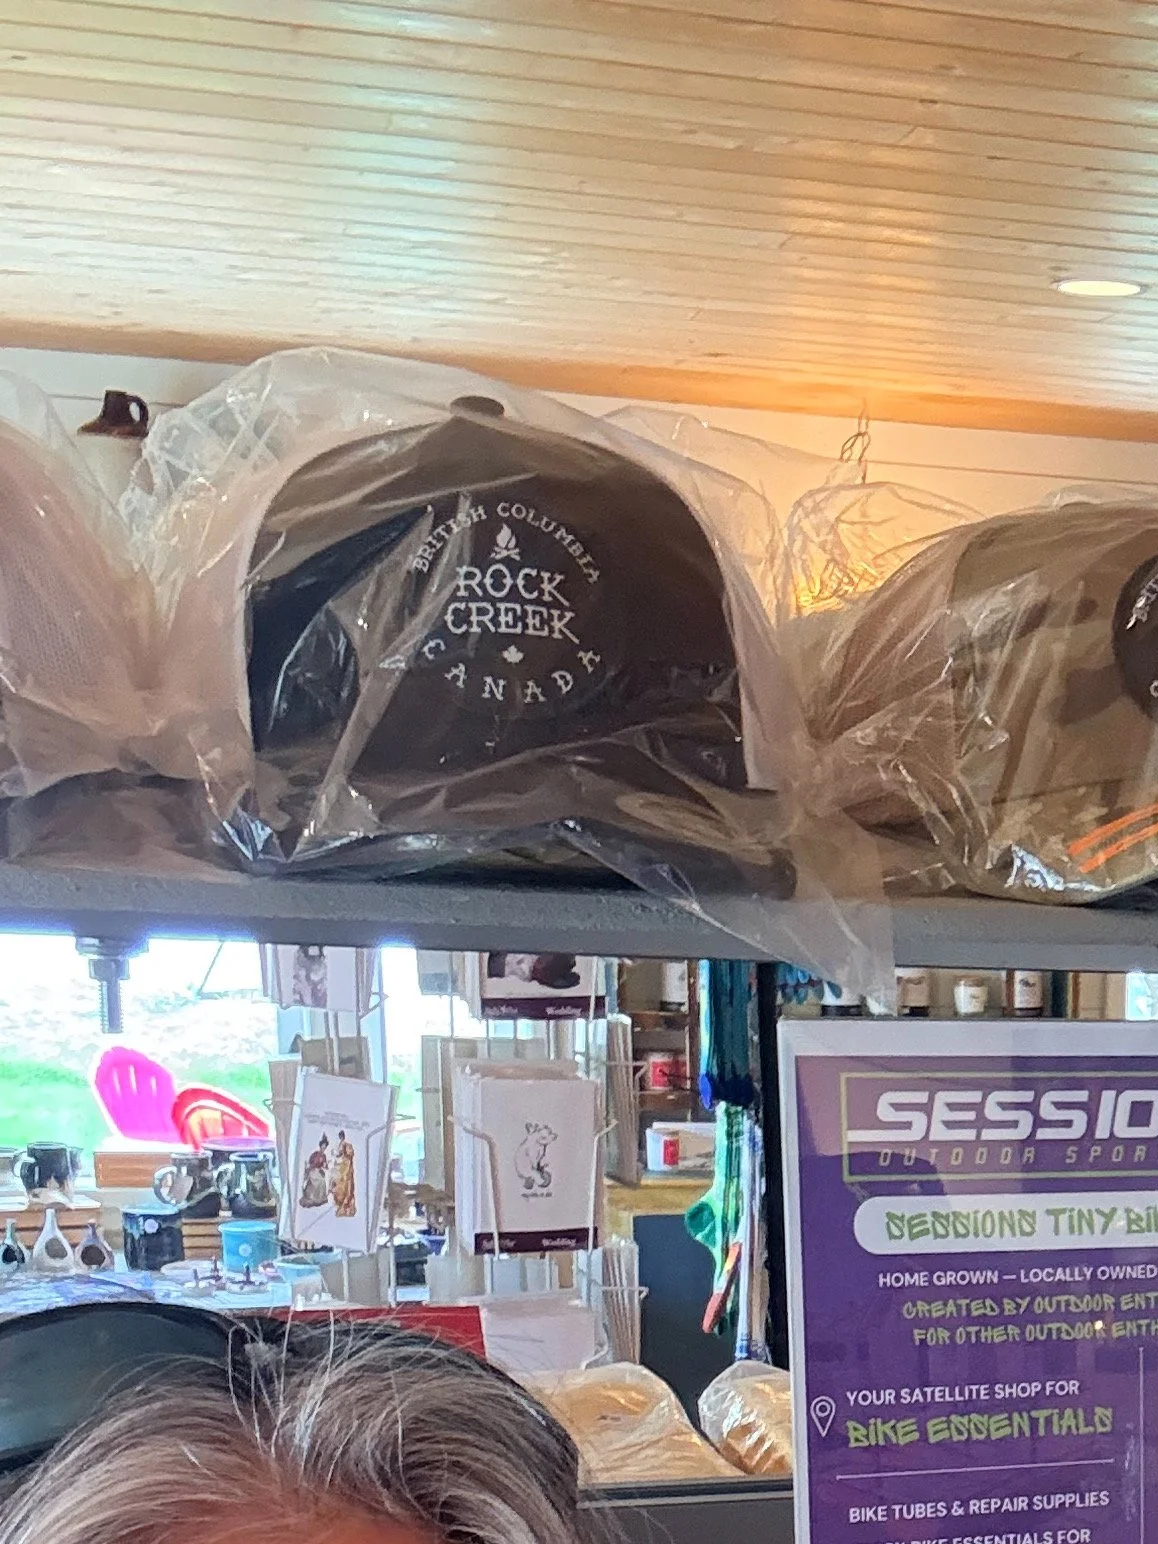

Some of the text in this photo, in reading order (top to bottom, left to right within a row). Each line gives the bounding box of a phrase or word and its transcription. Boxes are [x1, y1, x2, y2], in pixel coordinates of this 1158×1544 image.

[413, 502, 601, 584] BRITISH COLUMBIA
[455, 563, 570, 607] ROCK
[444, 601, 580, 645] CREEK
[422, 638, 601, 704] CANADA
[878, 1147, 1036, 1167] OUTDOOR
[885, 1207, 1037, 1242] SESSIONS
[1045, 1206, 1118, 1238] TINY
[878, 1271, 929, 1288] HOME
[932, 1270, 999, 1286] GROWN
[1020, 1265, 1093, 1283] LOCALLY
[1097, 1263, 1158, 1281] OWNED
[902, 1297, 1000, 1319] CREATED
[1003, 1296, 1031, 1317] BY
[1034, 1293, 1115, 1314] OUTDOOR
[913, 1325, 951, 1346] FOR
[956, 1322, 1020, 1344] OTHER
[1025, 1319, 1106, 1342] OUTDOOR
[846, 1379, 1080, 1407] YOUR SATELLITE SHOP FOR
[846, 1406, 1113, 1448] BIKE ESSENTIALS
[849, 1490, 1110, 1524] BIKE TUBES & REPAIR SUPPLIES
[1057, 1528, 1092, 1544] FOR
